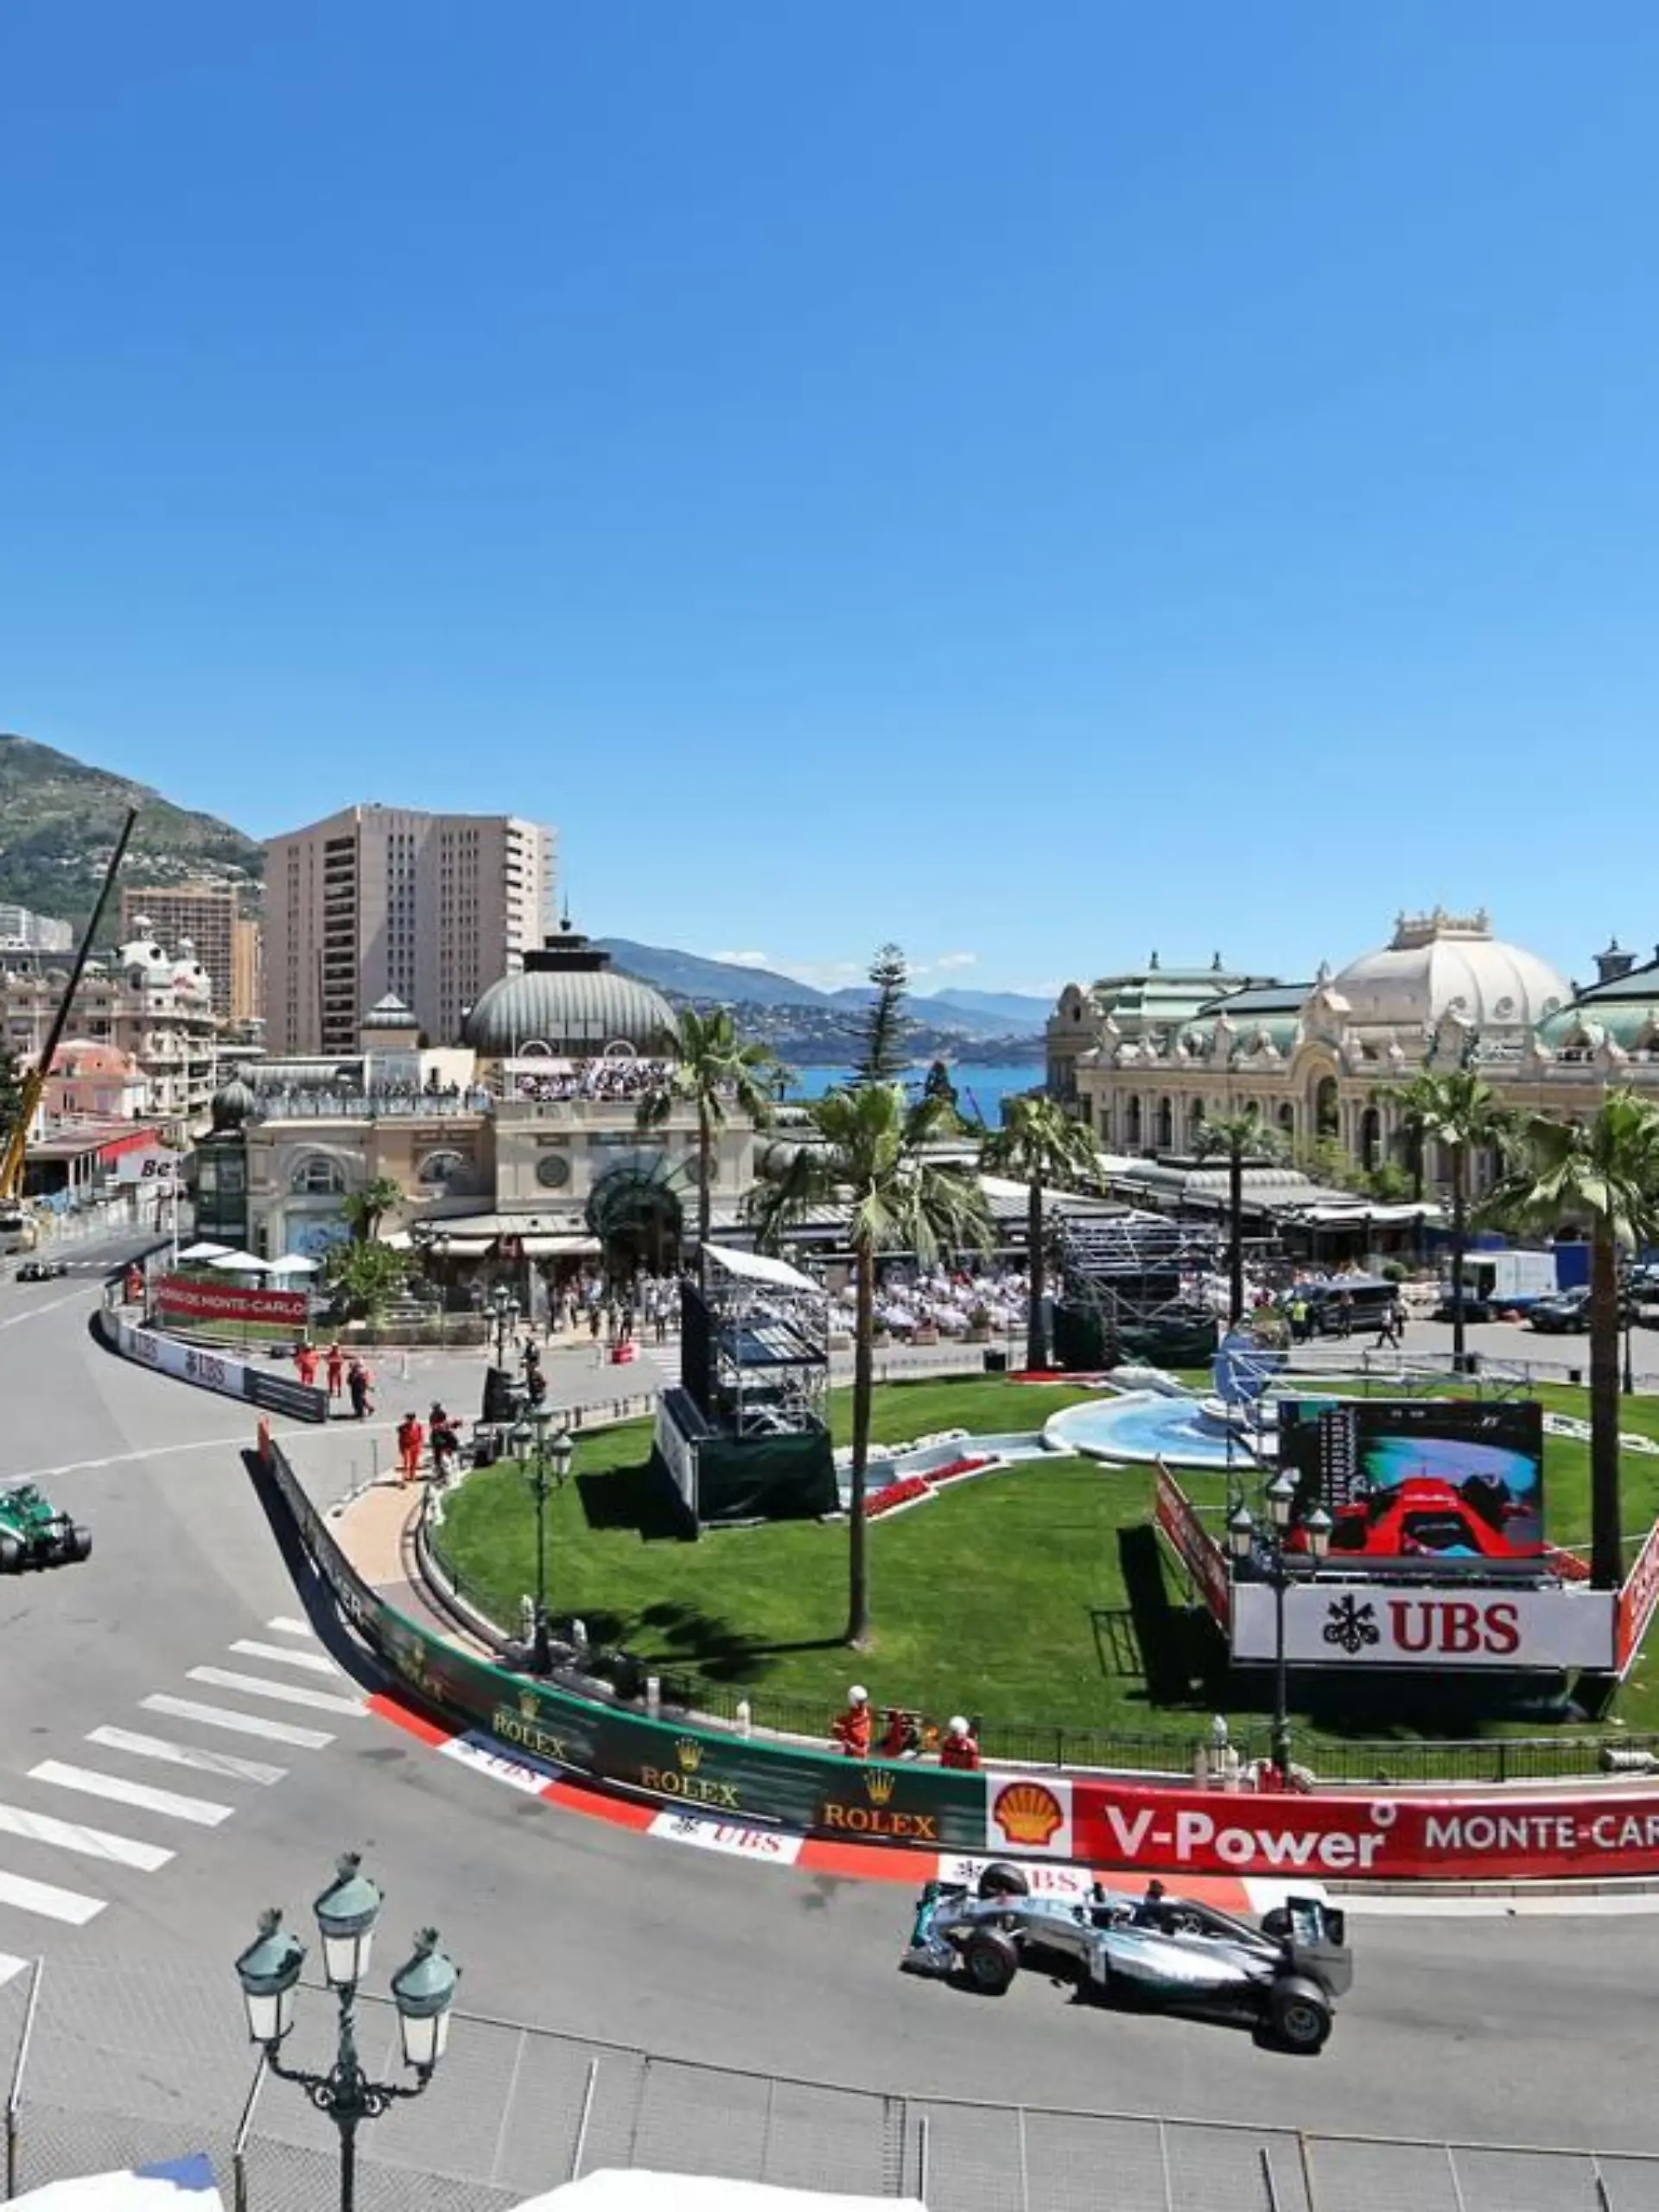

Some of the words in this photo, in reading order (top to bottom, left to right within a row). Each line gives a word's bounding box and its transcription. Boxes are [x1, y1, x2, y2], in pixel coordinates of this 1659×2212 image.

[1387, 1600, 1520, 1654] UBS
[493, 1710, 564, 1760] ROLEX
[640, 1765, 740, 1808] ROLEX
[713, 1820, 783, 1853] UBS
[825, 1802, 938, 1840] ROLEX
[1105, 1805, 1385, 1868] V-Power
[1032, 1869, 1078, 1891] BS
